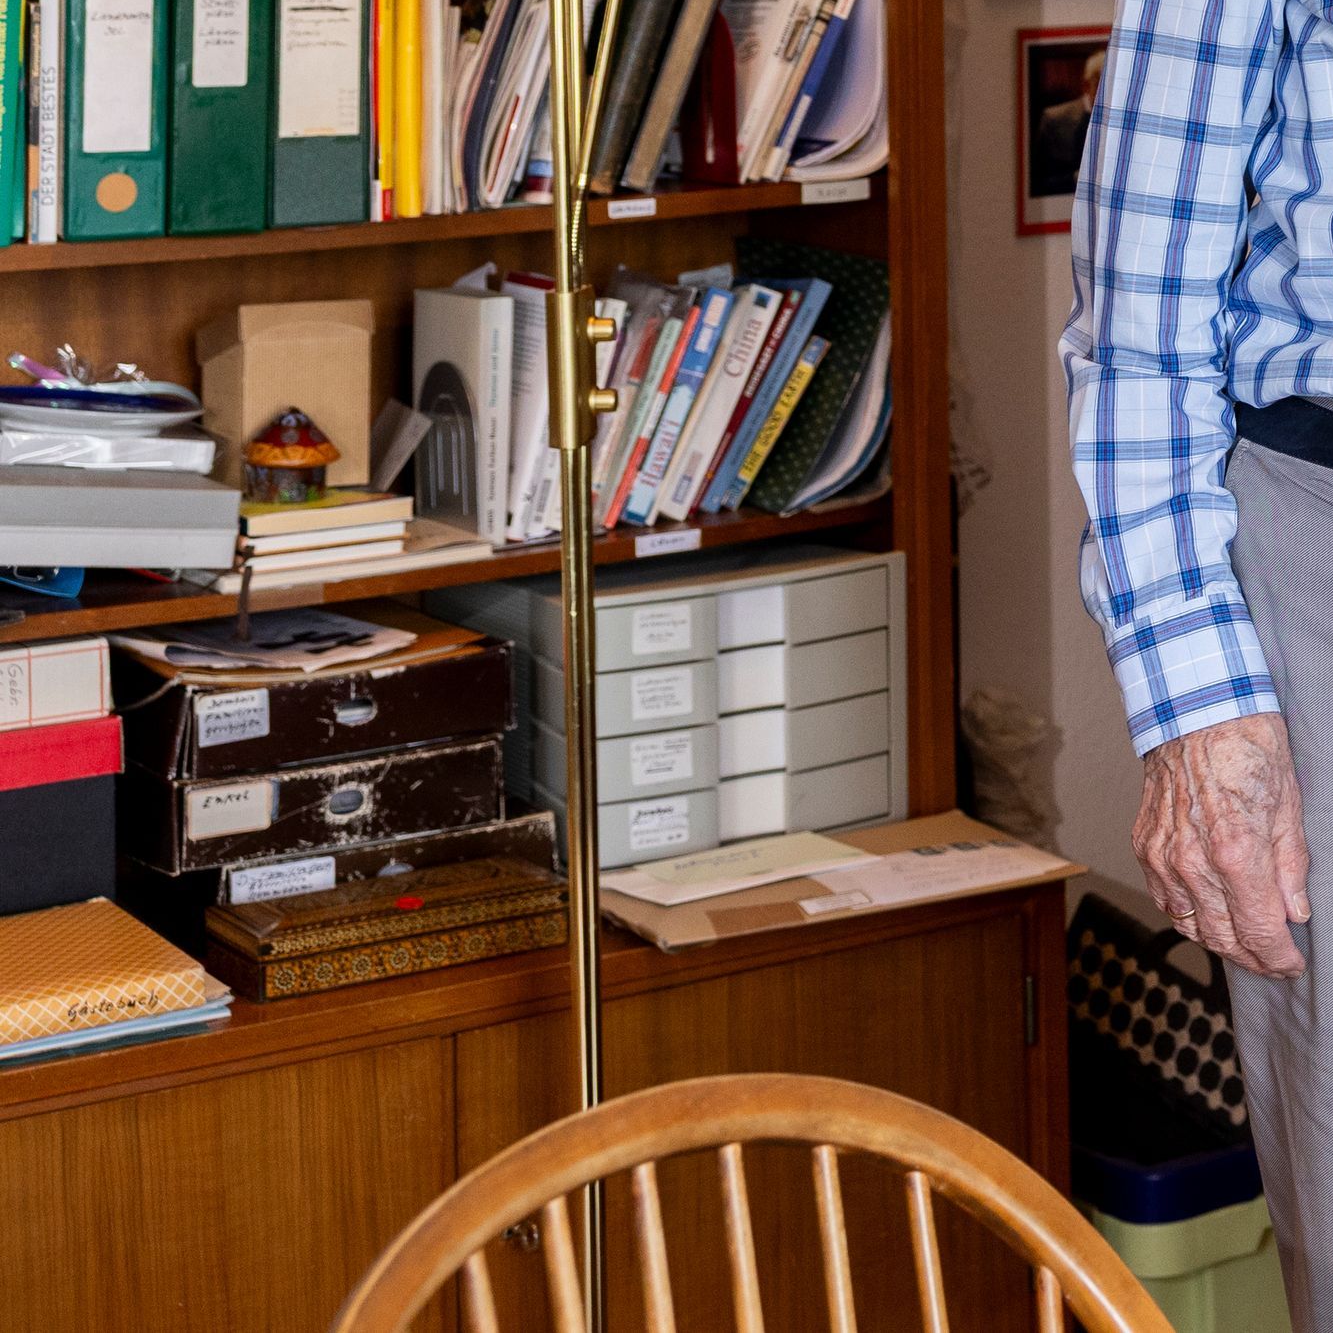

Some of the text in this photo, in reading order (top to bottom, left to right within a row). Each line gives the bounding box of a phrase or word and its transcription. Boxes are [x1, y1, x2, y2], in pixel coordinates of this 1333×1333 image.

[41, 66, 55, 206] DER STADT BESTES
[720, 315, 766, 381] China
[741, 366, 806, 474] THE GOOD EARTH
